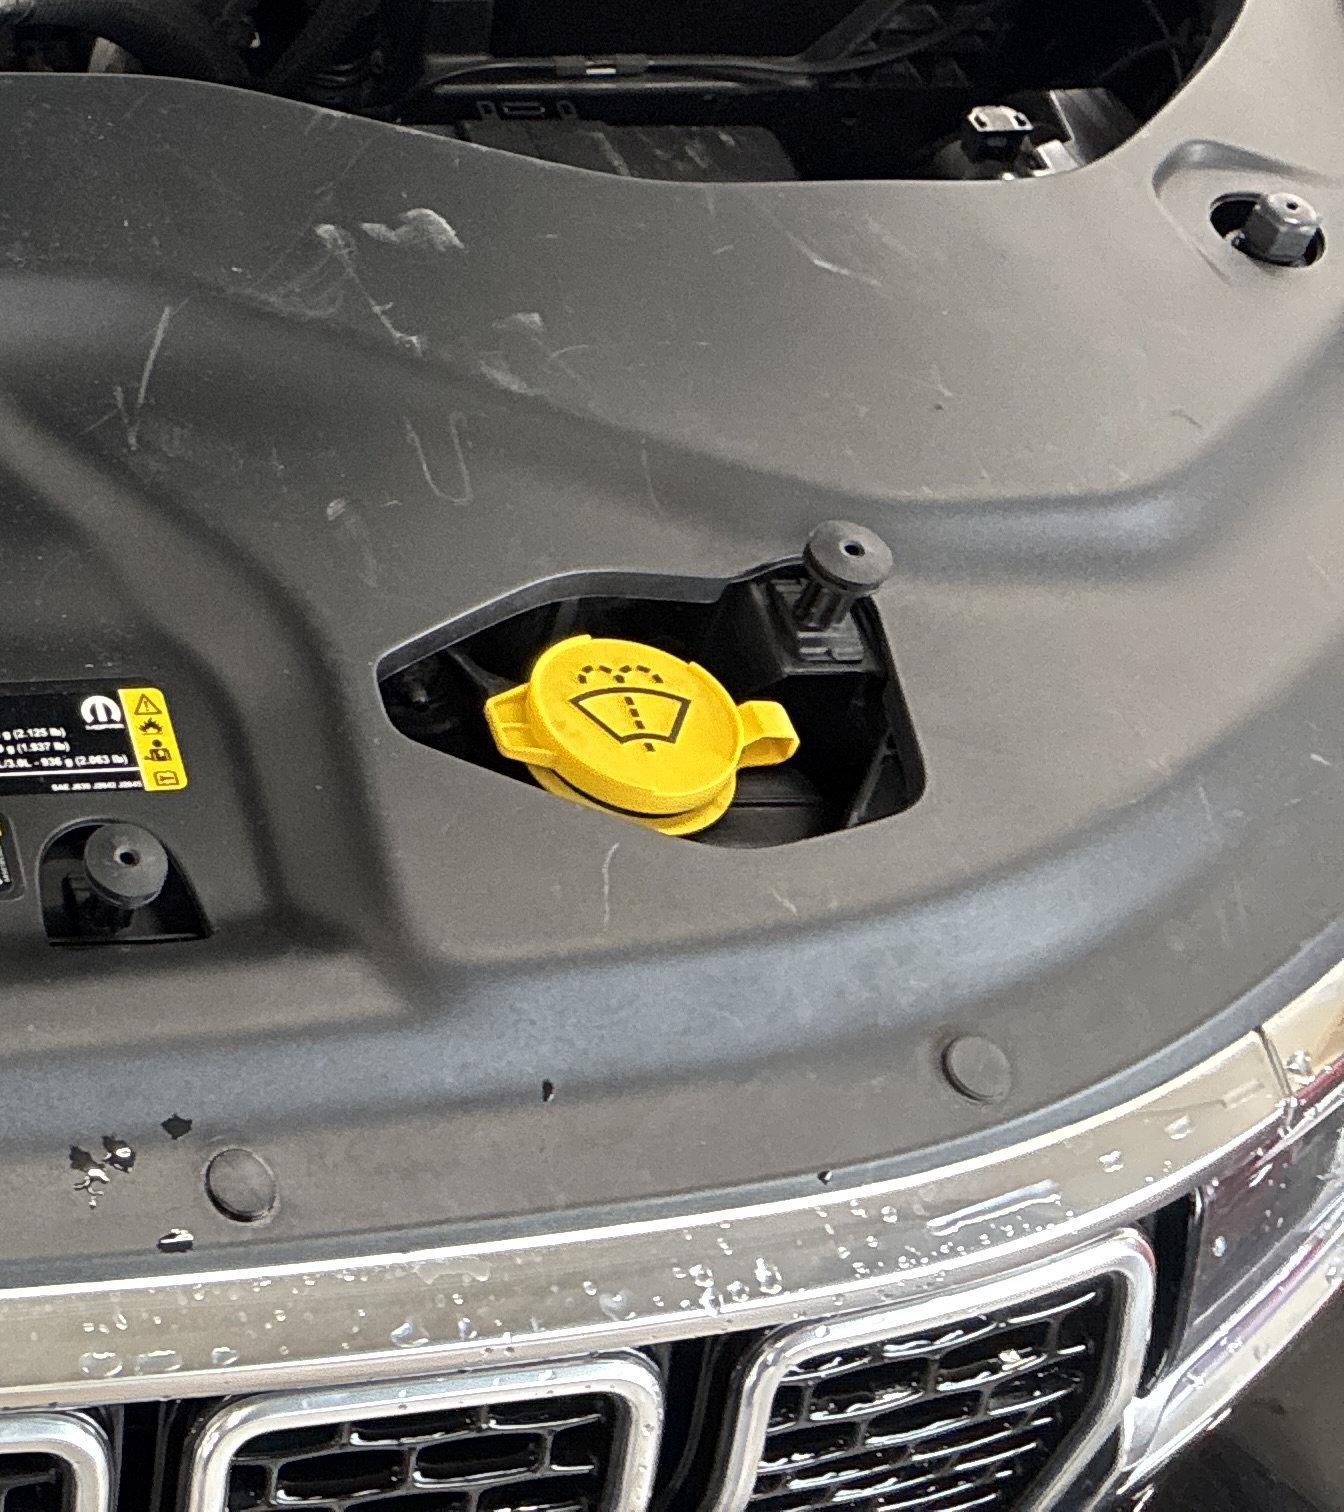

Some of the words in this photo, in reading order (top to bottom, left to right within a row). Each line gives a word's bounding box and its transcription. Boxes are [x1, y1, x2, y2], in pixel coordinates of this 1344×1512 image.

[12, 727, 49, 741] (2.125
[49, 727, 67, 739] lb)
[53, 741, 71, 753] lb)
[111, 753, 129, 766] lb)
